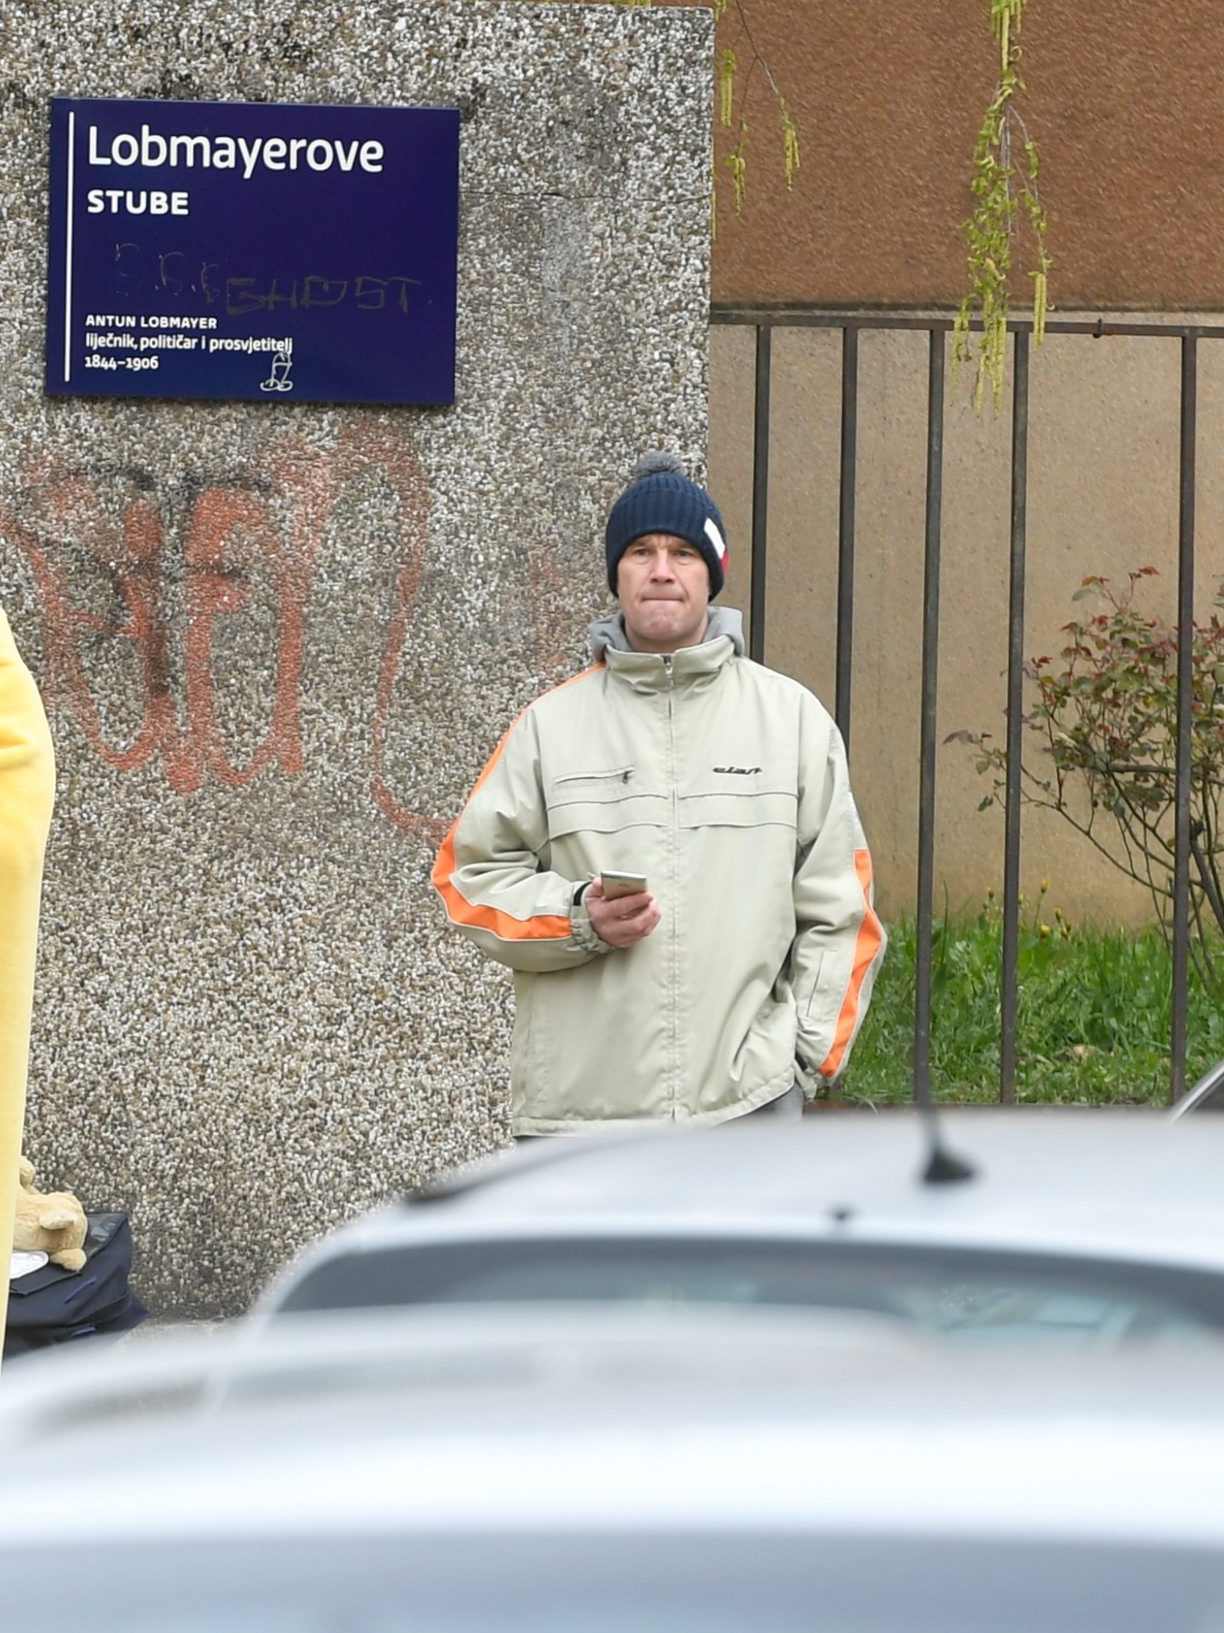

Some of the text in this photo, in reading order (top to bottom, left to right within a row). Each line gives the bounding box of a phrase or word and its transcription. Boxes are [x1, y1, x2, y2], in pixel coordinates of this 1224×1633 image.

[88, 124, 384, 179] Lobmayerove
[87, 189, 189, 215] STUBE
[85, 314, 218, 329] ANTUN LOBMAYER
[85, 332, 293, 355] liječnik, političar i prosvjetitelj
